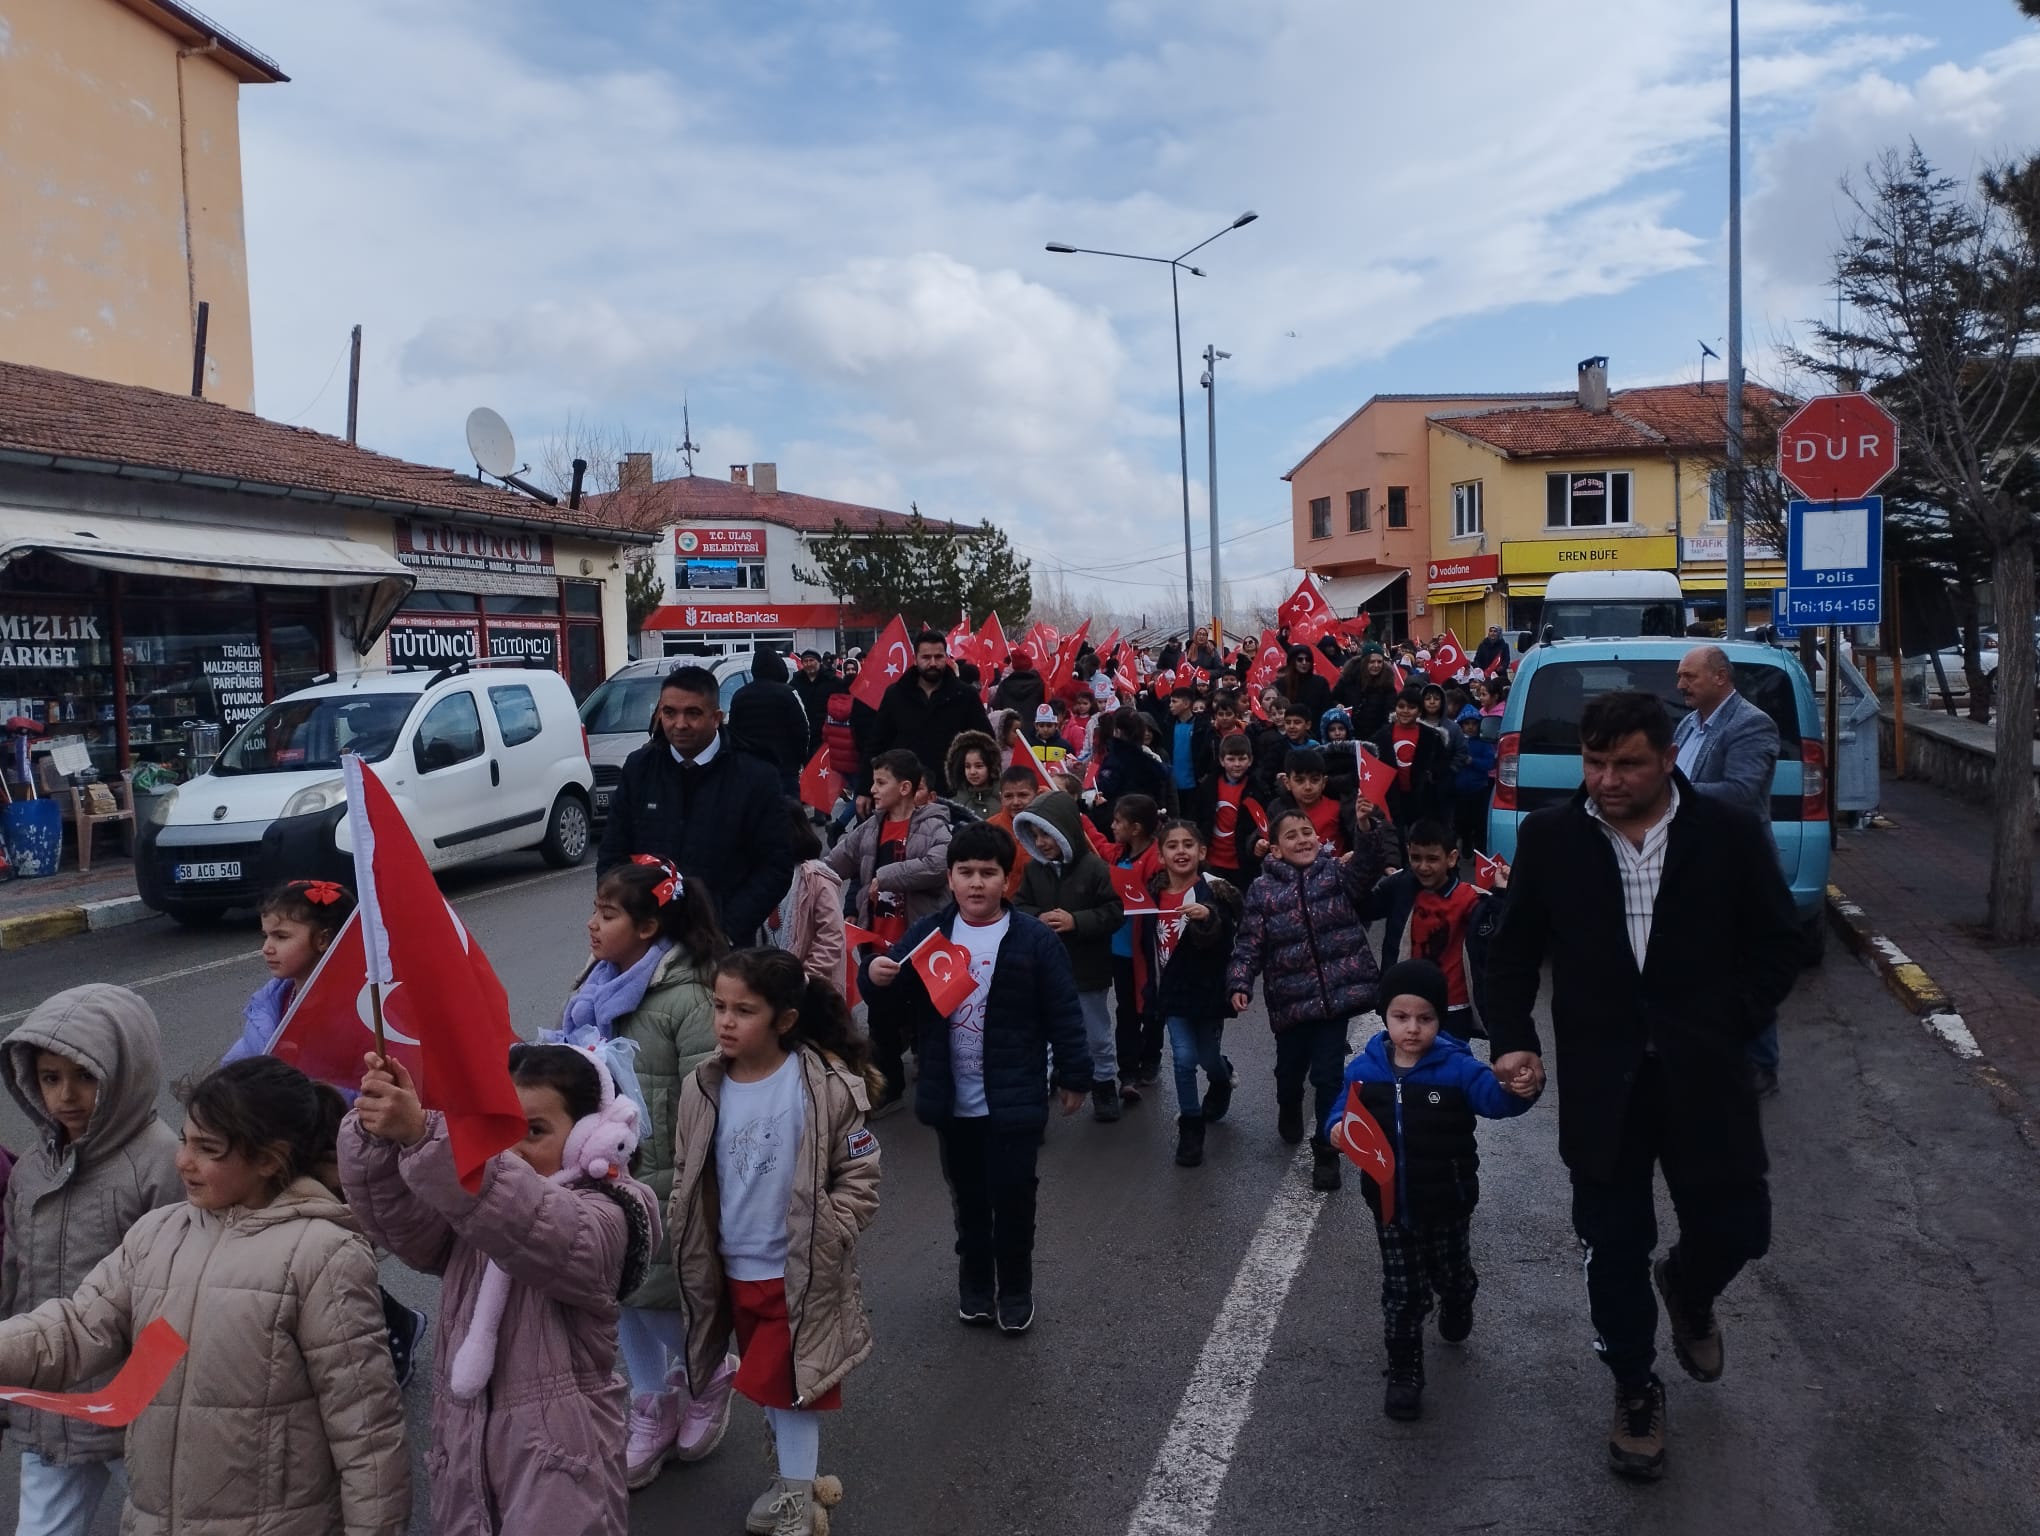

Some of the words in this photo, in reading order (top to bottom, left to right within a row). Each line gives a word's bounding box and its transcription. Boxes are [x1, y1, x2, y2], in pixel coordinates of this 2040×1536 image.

[1796, 434, 1879, 463] DUR
[422, 523, 533, 561] TÜTÜNCÜ
[709, 531, 726, 540] T.C.
[728, 531, 752, 542] ULAŞ
[702, 542, 759, 552] BELEDİYESİ
[1558, 551, 1587, 562] EREN
[1590, 547, 1619, 560] BÜFE
[1440, 564, 1470, 576] vodafone
[1816, 572, 1854, 584] Polis
[700, 610, 735, 623] Ziraat
[736, 610, 779, 623] Bankası
[222, 642, 261, 657] TEMİZLİK
[391, 628, 476, 657] TÜTÜNCÜ
[491, 637, 551, 654] TÜTÜNCÜ
[203, 659, 262, 673] MALZEMELERİ
[213, 674, 263, 689] PARFÜMERİ
[222, 692, 264, 705] OYUNCAK
[180, 866, 192, 878] 58
[197, 864, 215, 877] ACG
[220, 863, 239, 876] 540
